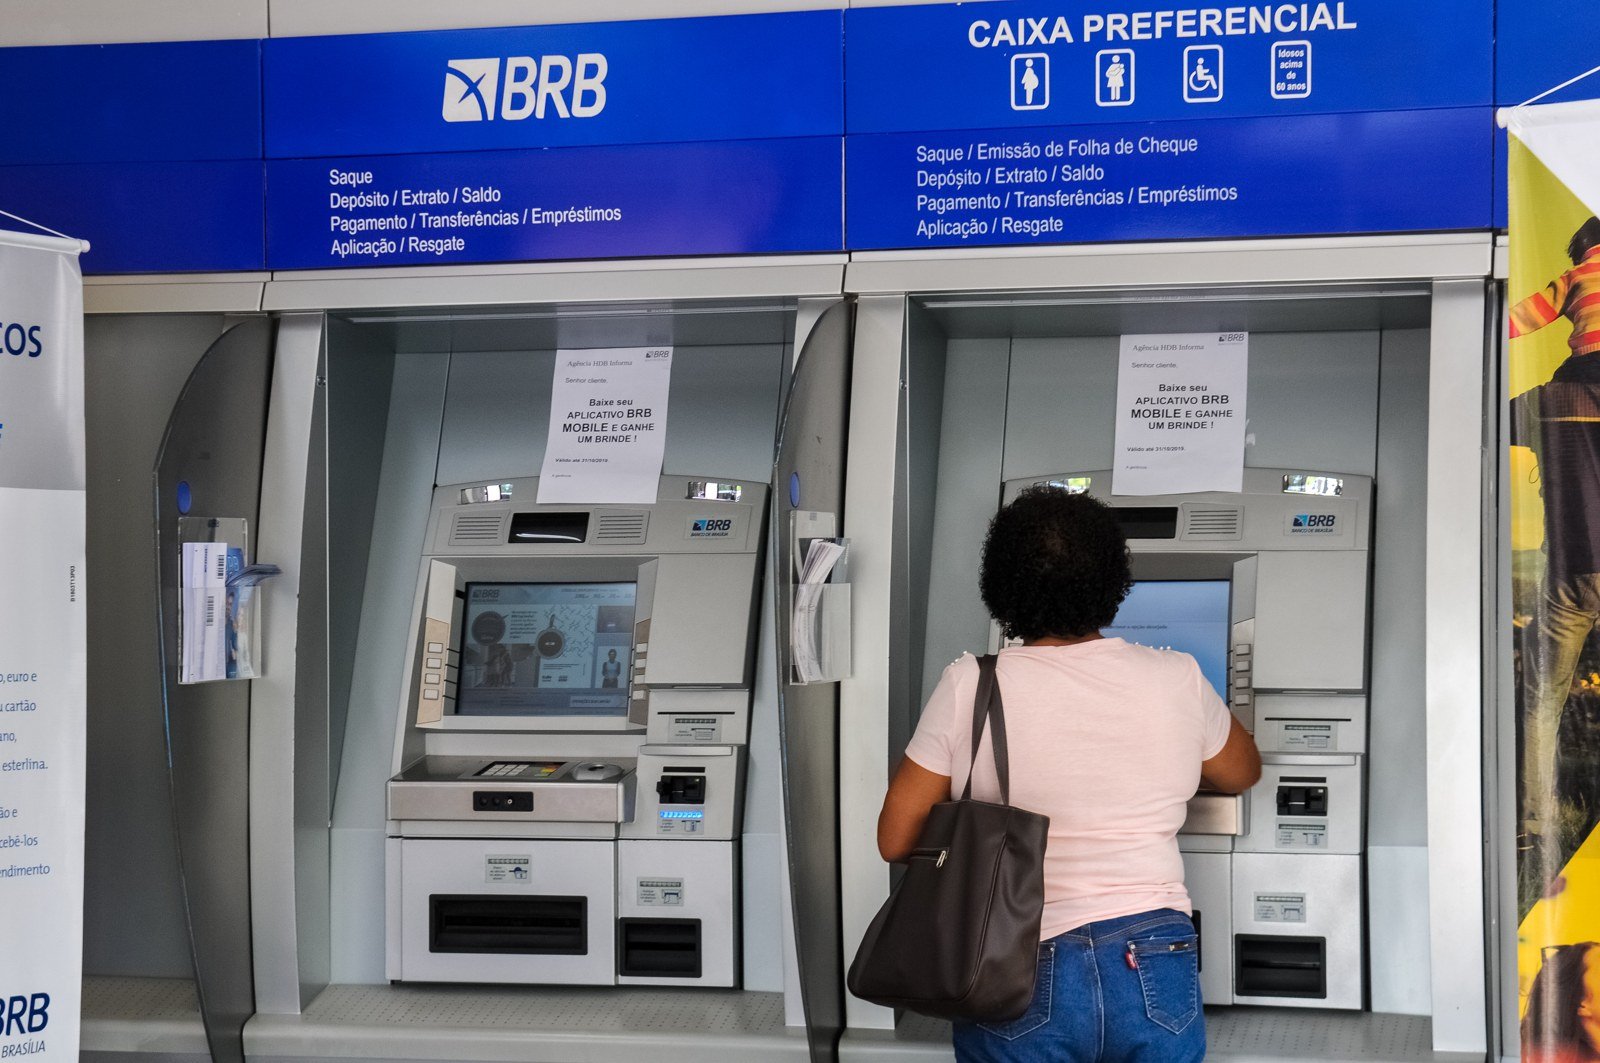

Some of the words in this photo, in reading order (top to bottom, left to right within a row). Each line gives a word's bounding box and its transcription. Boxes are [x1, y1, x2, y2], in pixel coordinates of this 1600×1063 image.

[968, 16, 1074, 48] CAIXA
[1083, 2, 1358, 43] PREFERENCIAL
[1278, 49, 1304, 58] Idosos
[1280, 59, 1303, 69] acima
[1286, 70, 1296, 79] de
[501, 53, 608, 121] BRB
[1276, 82, 1286, 91] 60
[1287, 83, 1306, 91] anos
[916, 145, 964, 165] Saque
[967, 144, 974, 160] /
[977, 142, 1041, 160] Emissão
[1045, 141, 1064, 157] de
[1069, 139, 1110, 156] Folha
[1114, 138, 1134, 155] de
[1138, 136, 1198, 156] Cheque
[329, 169, 373, 188] Saque
[917, 168, 981, 190] Depósito
[985, 168, 991, 184] /
[995, 166, 1047, 184] Extrato
[1051, 165, 1057, 182] /
[1061, 164, 1104, 182] Saldo
[330, 191, 389, 211] Depósito
[392, 190, 398, 206] /
[401, 189, 449, 206] Extrato
[452, 188, 458, 204] /
[461, 186, 501, 203] Saldo
[917, 193, 1001, 215] Pagamento
[1004, 192, 1010, 208] /
[1014, 189, 1124, 208] Transferências
[1128, 188, 1134, 204] /
[1138, 185, 1238, 207] Empréstimos
[330, 214, 408, 235] Pagamento
[410, 213, 416, 229] /
[419, 210, 519, 229] Transferências
[522, 208, 528, 224] /
[531, 206, 622, 227] Empréstimos
[916, 218, 988, 240] Aplicação
[991, 217, 998, 234] /
[1001, 216, 1064, 237] Resgate
[331, 238, 396, 258] Aplicação
[399, 237, 405, 253] /
[408, 236, 465, 255] Resgate
[0, 321, 42, 358] OS
[1227, 333, 1244, 342] BRB
[653, 350, 669, 358] BRB
[1158, 384, 1186, 392] Baixe
[1189, 384, 1208, 392] seu
[589, 398, 614, 407] Baixe
[1135, 397, 1198, 405] APLICATIVO
[1201, 394, 1229, 405] BRB
[567, 410, 624, 419] APLICATIVO
[626, 408, 652, 418] BRB
[1131, 408, 1181, 419] MOBILE
[1185, 410, 1192, 418] E
[1195, 409, 1233, 418] GANHE
[562, 423, 608, 432] MOBILE
[620, 423, 655, 431] GANHE
[1148, 421, 1164, 430] UM
[1167, 421, 1207, 430] BRINDE
[577, 435, 592, 443] UM
[595, 434, 631, 443] BRINDE
[706, 519, 731, 531] BRB
[1308, 515, 1335, 527] BRB
[7, 672, 29, 682] euro
[31, 672, 37, 682] e
[5, 699, 37, 712] cartão
[2, 758, 48, 772] esterlina.
[12, 808, 18, 818] e
[0, 863, 50, 878] ndimento
[1, 1038, 46, 1059] BRASÍLIA
